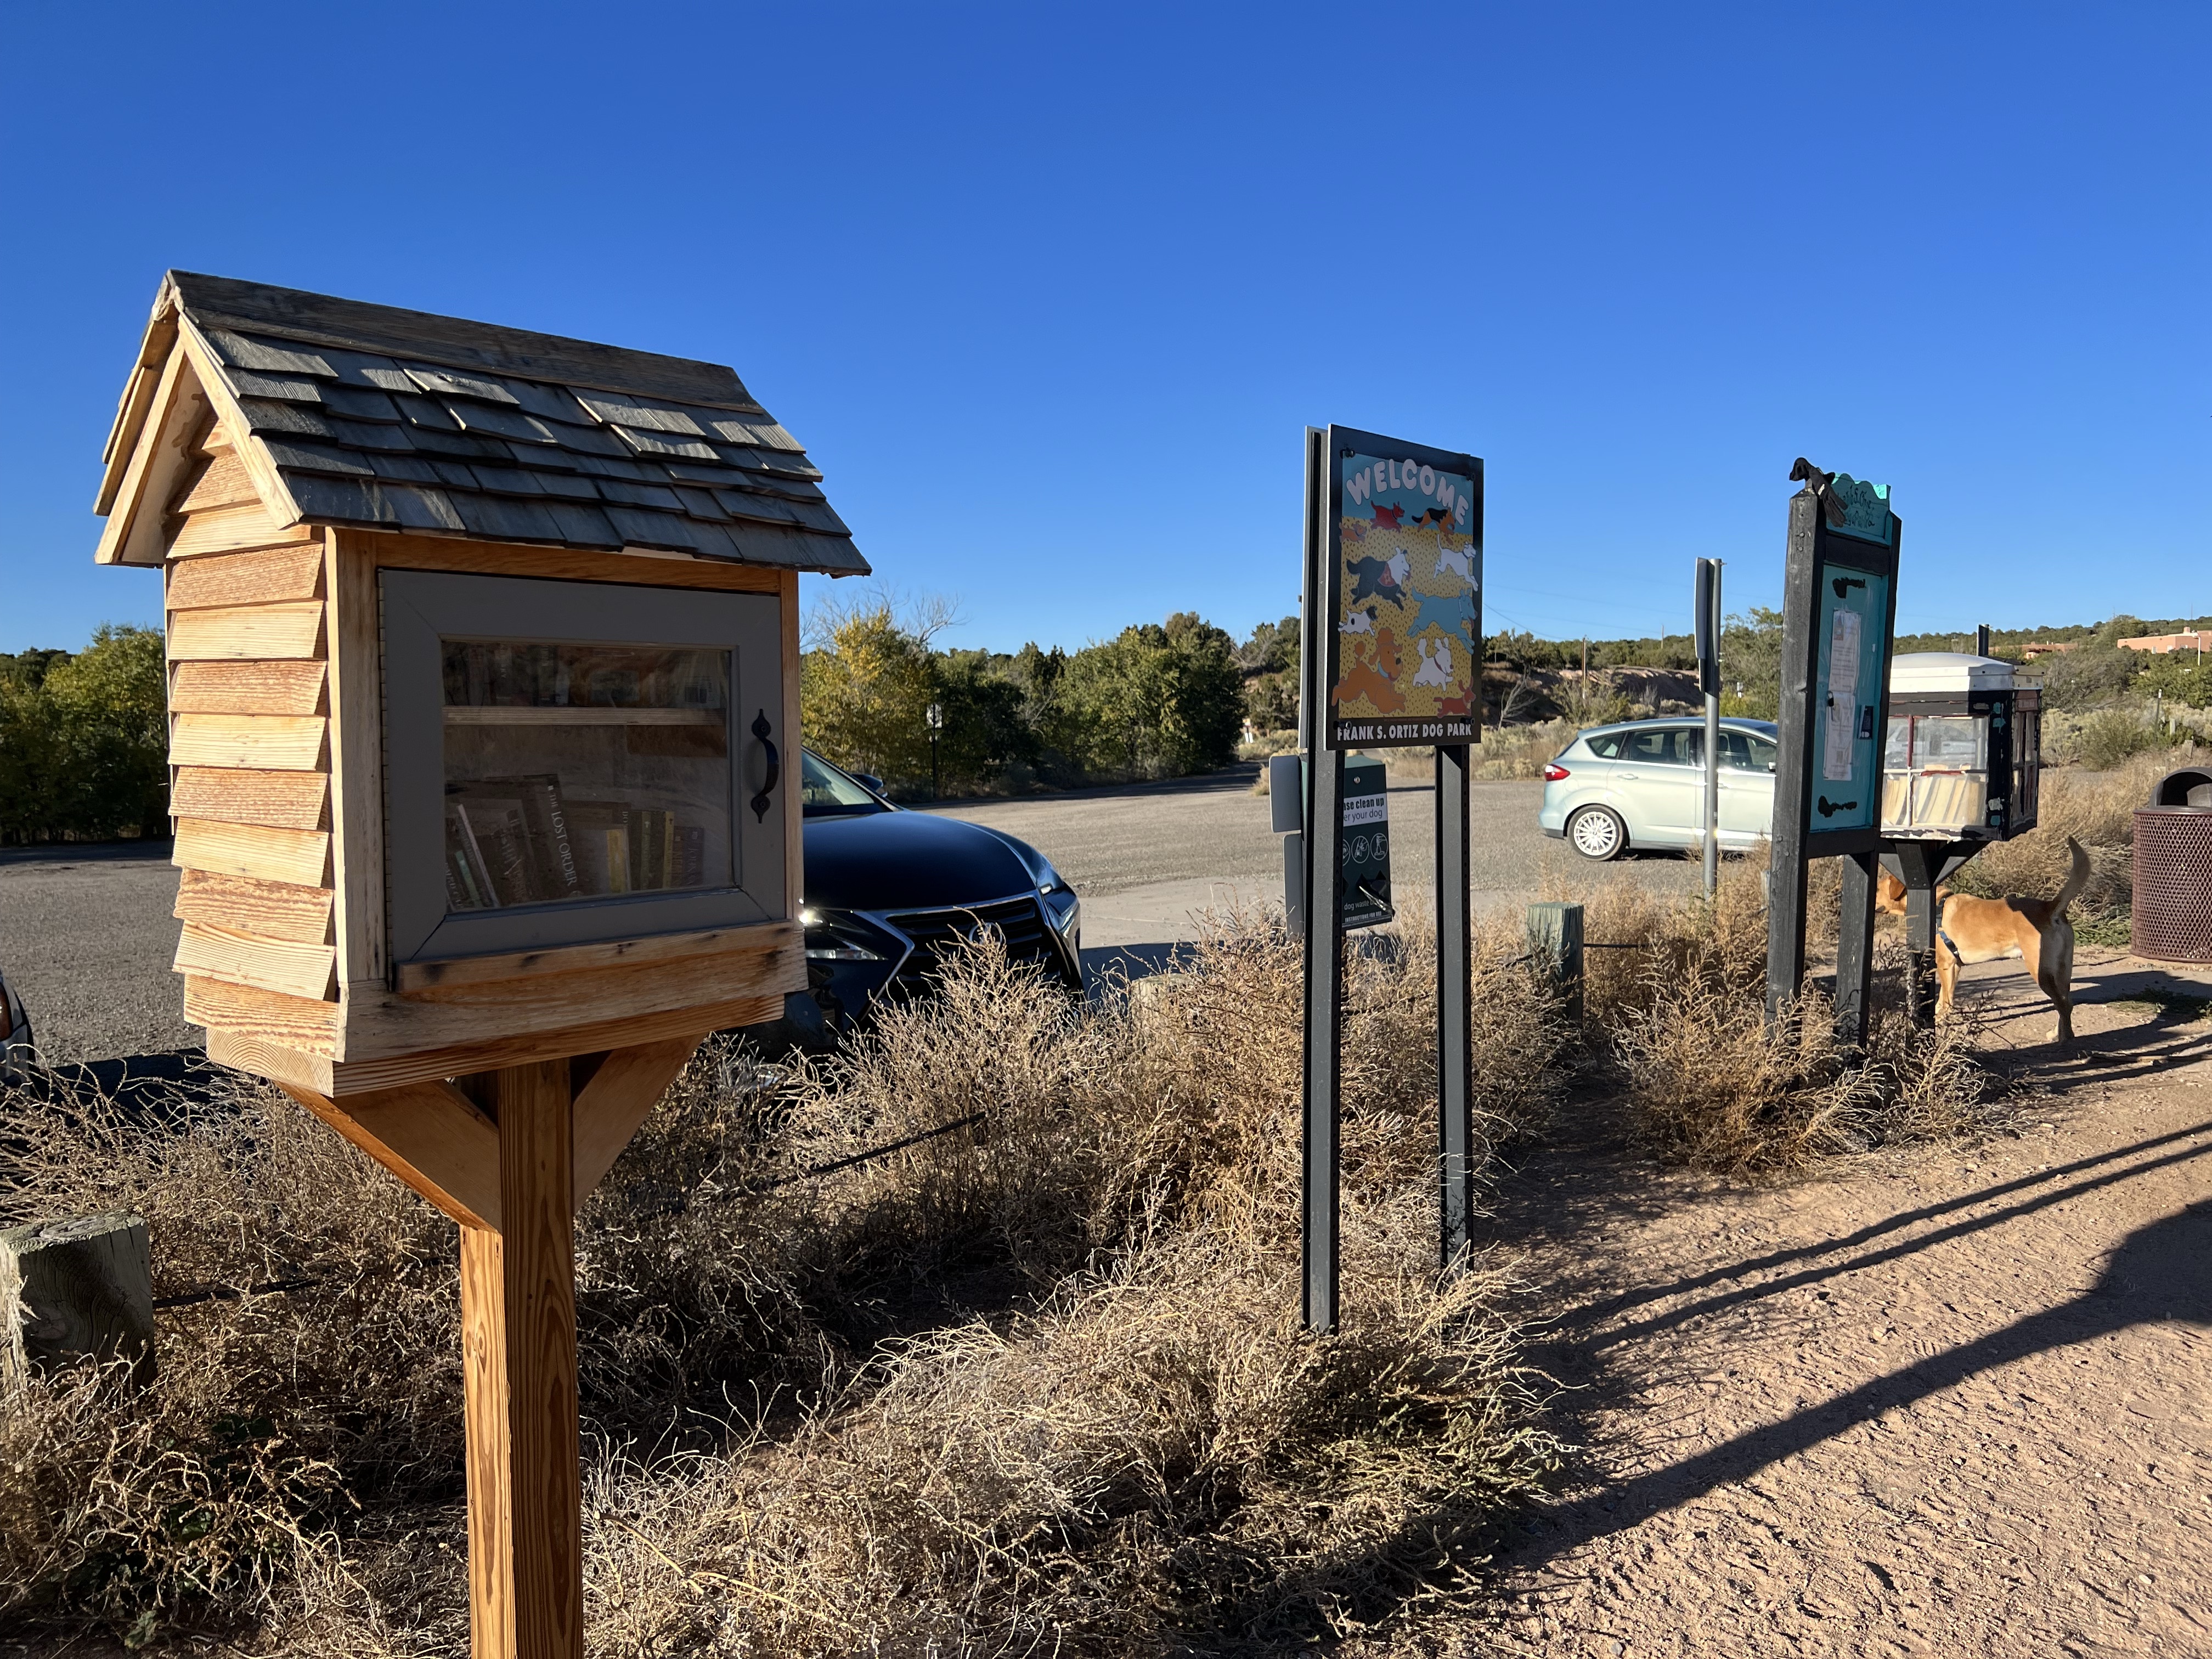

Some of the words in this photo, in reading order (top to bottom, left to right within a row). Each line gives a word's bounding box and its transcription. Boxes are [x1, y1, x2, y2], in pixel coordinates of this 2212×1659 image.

[1346, 458, 1469, 526] WELCOME
[1337, 725, 1374, 741] FRANK
[1376, 725, 1387, 740] S.
[1389, 724, 1419, 739] ORTIZ
[1422, 723, 1443, 737] DOG
[1447, 723, 1472, 737] PARK
[1356, 799, 1375, 809] clean
[1375, 798, 1384, 807] up
[1352, 811, 1367, 823] your
[1369, 809, 1383, 819] dog
[551, 811, 568, 840] LOST
[558, 843, 577, 887] ORDER
[1344, 902, 1355, 911] dog
[1355, 900, 1369, 909] waste
